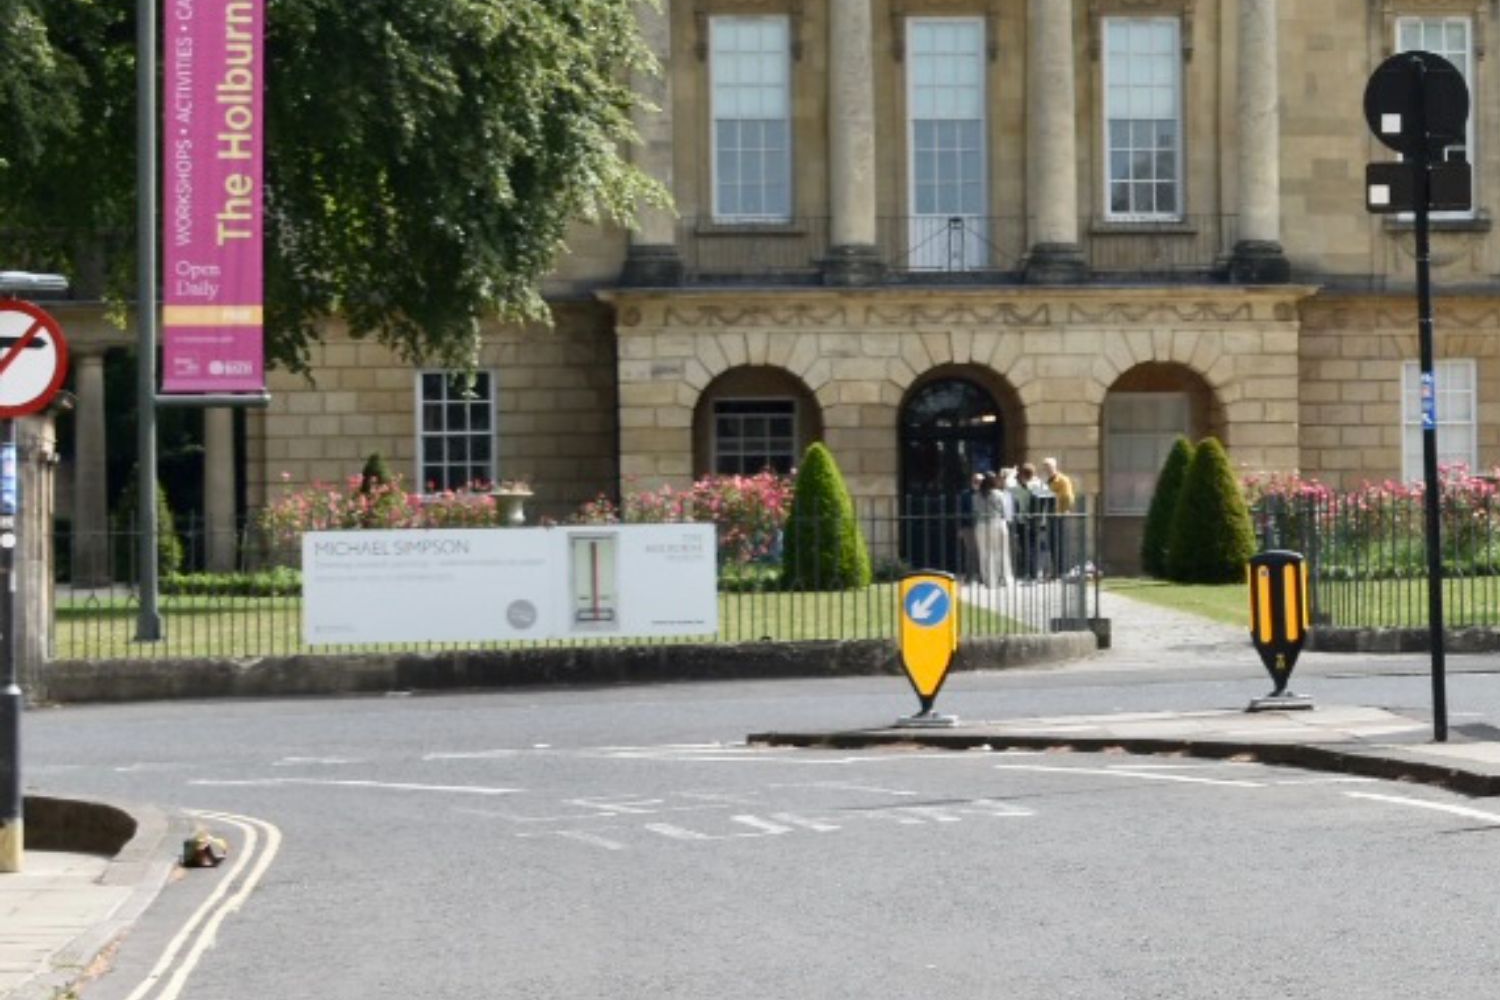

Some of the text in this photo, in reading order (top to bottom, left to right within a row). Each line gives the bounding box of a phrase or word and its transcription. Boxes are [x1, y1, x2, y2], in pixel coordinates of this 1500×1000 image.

[175, 37, 193, 123] ACTIVITIES
[175, 139, 193, 246] WORKSHOPS
[217, 173, 253, 246] The
[175, 260, 220, 280] Open
[175, 280, 220, 301] Daily
[315, 538, 470, 557] MICHAEL SIMPSON
